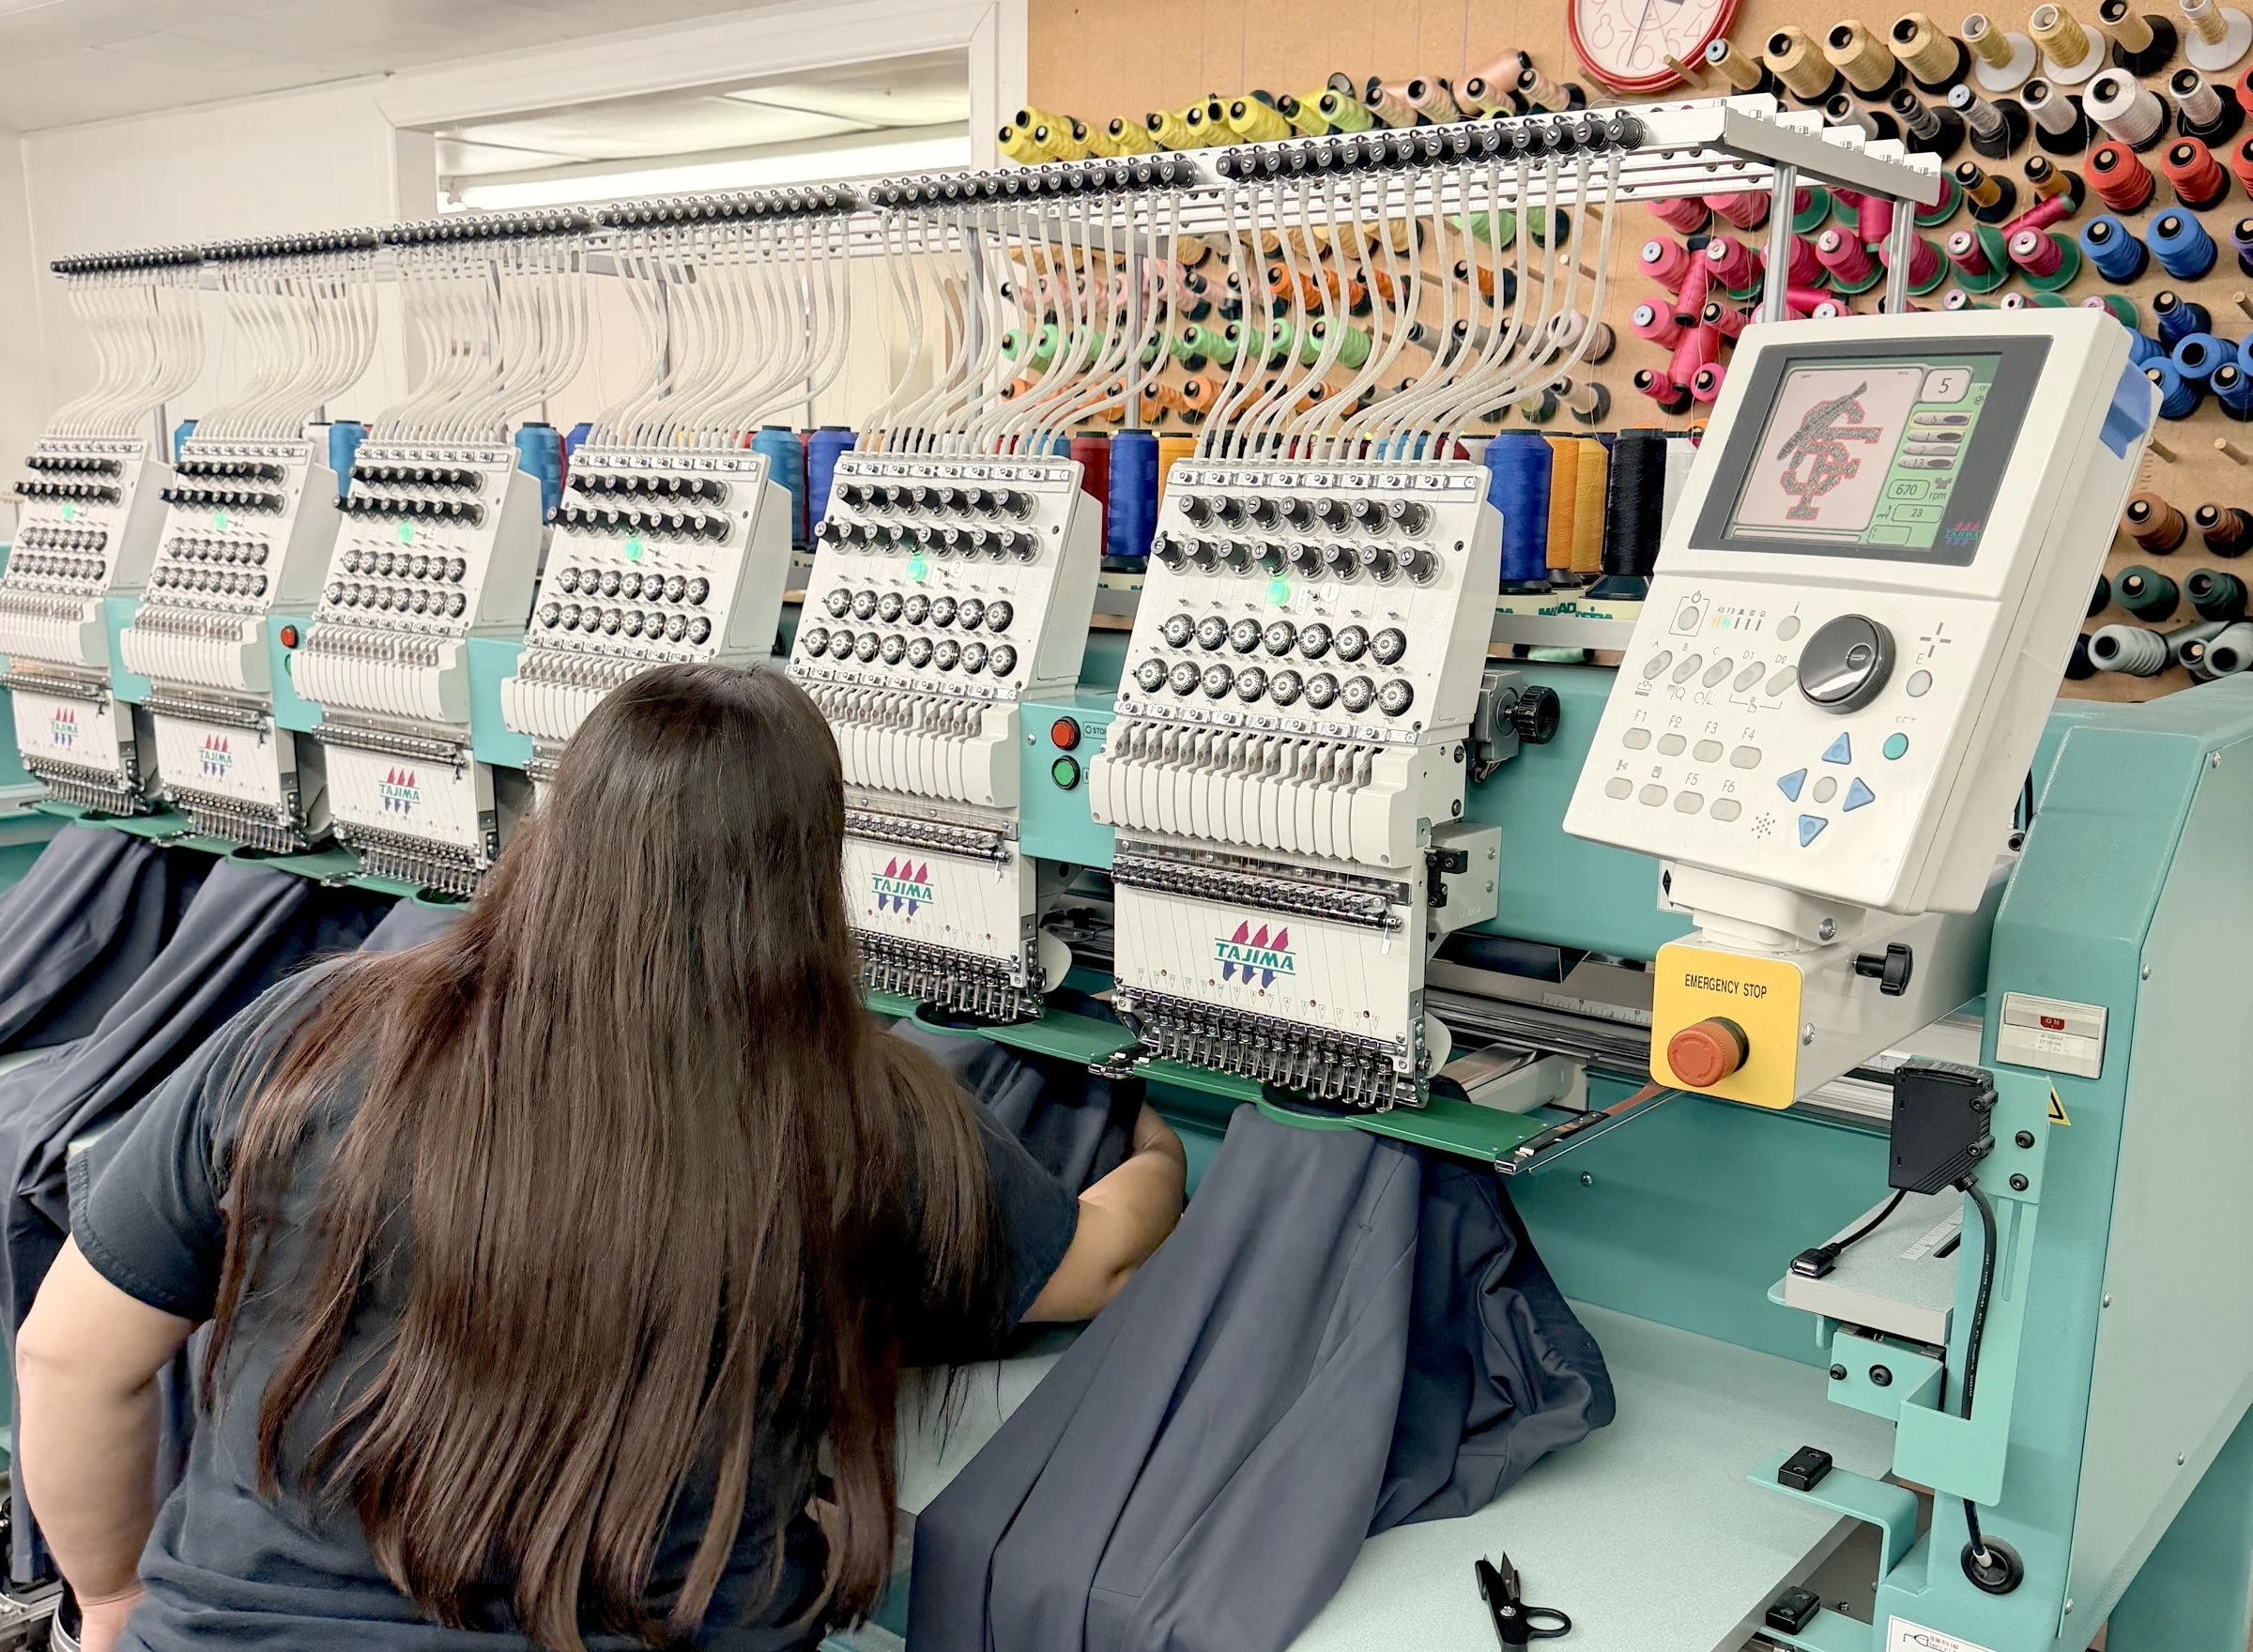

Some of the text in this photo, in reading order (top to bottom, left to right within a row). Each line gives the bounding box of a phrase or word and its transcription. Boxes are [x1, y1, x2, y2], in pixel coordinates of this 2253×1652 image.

[1592, 13, 1615, 50] 8
[1682, 10, 1704, 43] 4
[1616, 29, 1633, 67] 7
[1631, 34, 1655, 70] 6
[1939, 377, 1953, 394] 5
[1895, 483, 1918, 496] 670
[1928, 492, 1947, 501] rpm
[1910, 508, 1923, 518] 23
[1945, 529, 1980, 540] TAJIMA
[953, 561, 961, 574] 2
[1652, 640, 1660, 649] A
[1682, 642, 1689, 651] B
[1712, 646, 1720, 655] C
[1742, 650, 1755, 660] D1
[1774, 654, 1788, 664] D2
[1915, 652, 1925, 665] E
[1633, 709, 1648, 723] F1
[1668, 714, 1683, 728] F2
[1704, 720, 1719, 735] F3
[1741, 727, 1756, 741] F4
[198, 749, 233, 764] TAJIMA
[1685, 772, 1699, 786] F5
[1722, 779, 1736, 793] F6
[378, 784, 420, 801] TAJIMA
[872, 877, 933, 901] TAJIMA
[1215, 942, 1295, 971] TAJIMA
[1684, 973, 1768, 999] EMERGENCY STOP
[2045, 1017, 2061, 1026] ON
